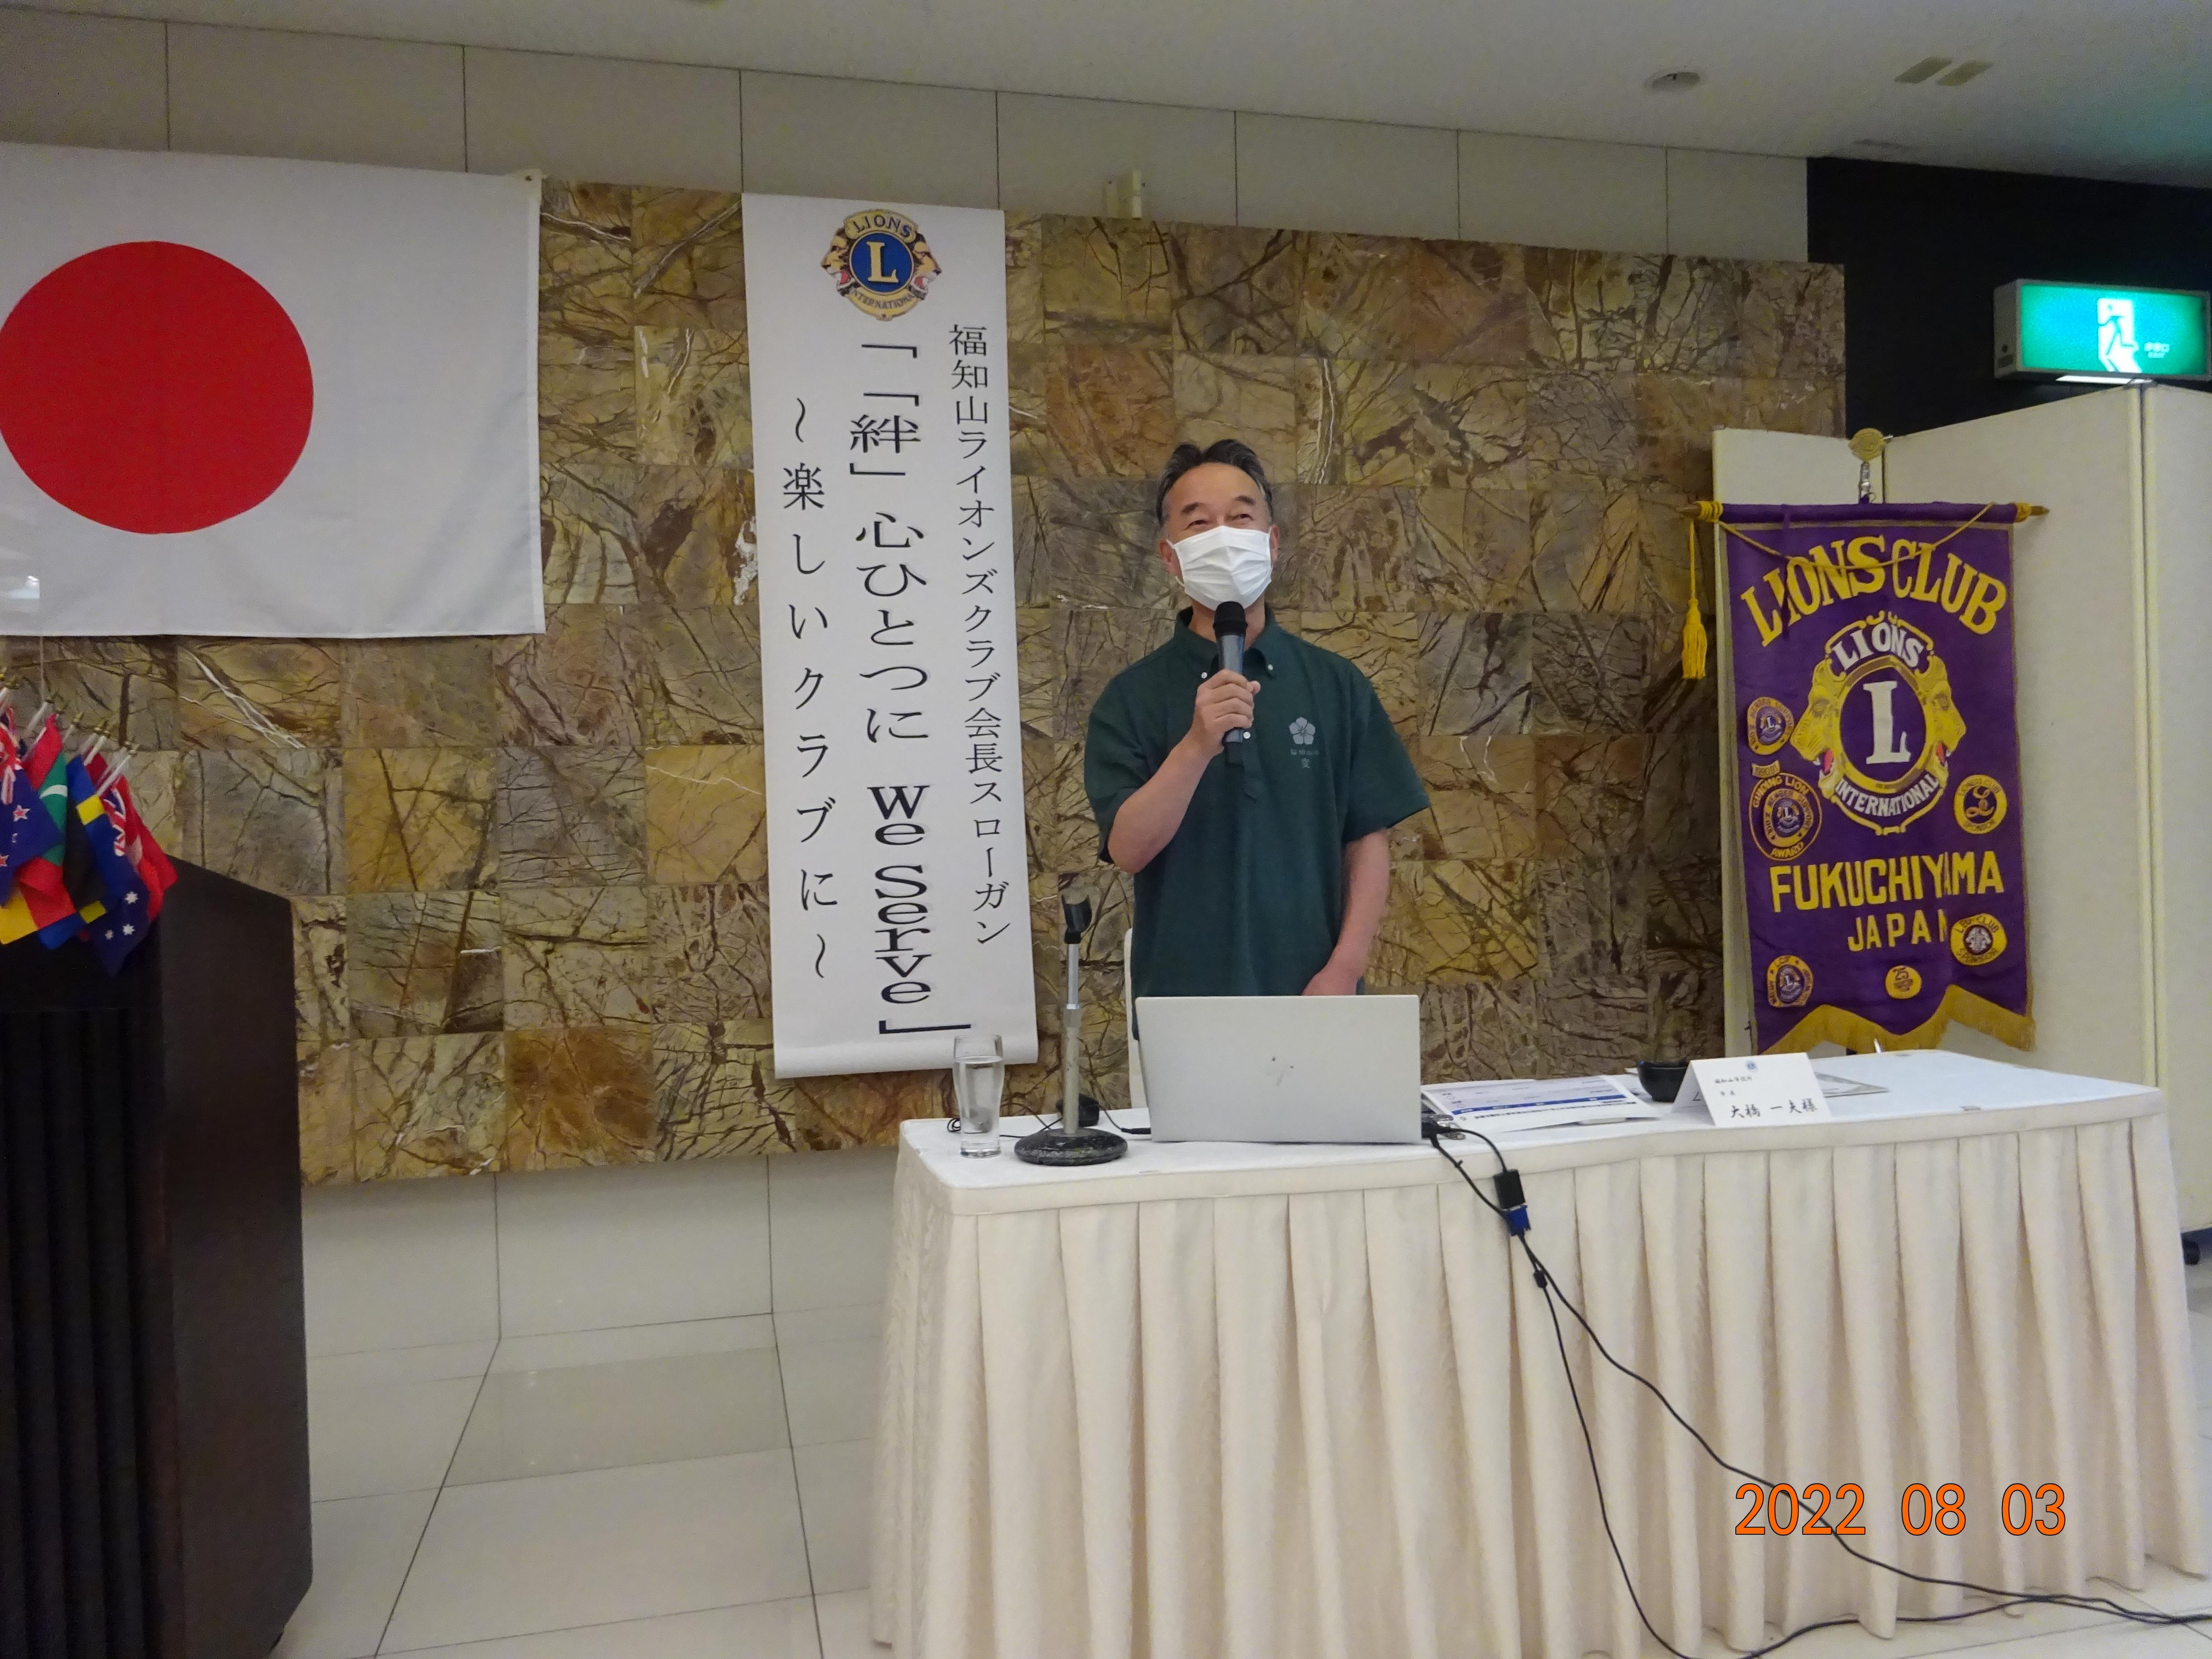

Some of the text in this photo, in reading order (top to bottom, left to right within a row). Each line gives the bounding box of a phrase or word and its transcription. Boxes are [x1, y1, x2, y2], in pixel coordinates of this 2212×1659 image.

[853, 215, 912, 238] LIONS
[866, 241, 899, 283] L
[1740, 535, 2008, 647] LIONS CLUB
[949, 324, 1011, 944] 福知山ライオンズクラブ会長スローガン
[1832, 623, 1925, 670] LIONS
[1863, 680, 1911, 764] L
[1785, 776, 1810, 795] LION
[1835, 773, 1939, 817] INTERNATIONAL
